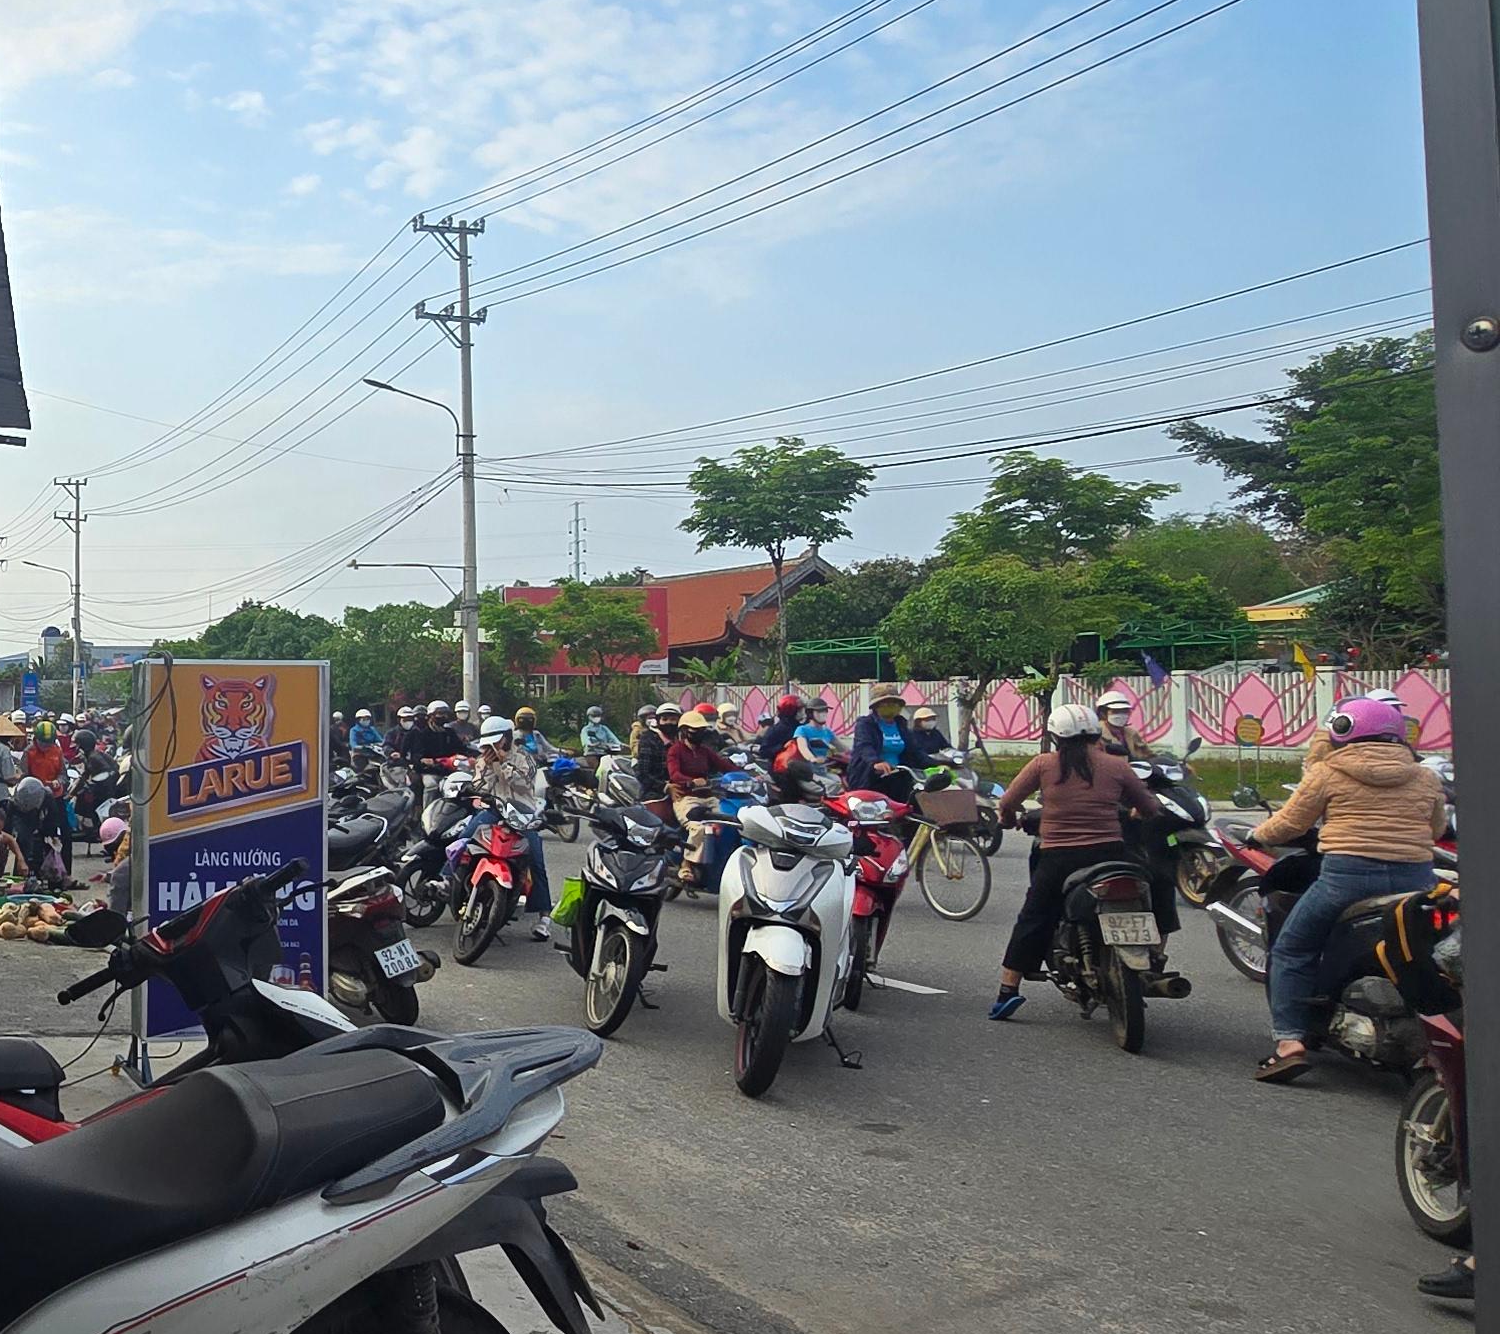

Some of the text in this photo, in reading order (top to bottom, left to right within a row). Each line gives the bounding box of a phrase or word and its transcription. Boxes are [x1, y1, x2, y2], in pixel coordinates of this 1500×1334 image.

[179, 751, 293, 806] LARUE
[195, 848, 281, 866] LÀNG NƯỚNG
[1111, 929, 1152, 942] 6173
[384, 954, 419, 976] 200.84
